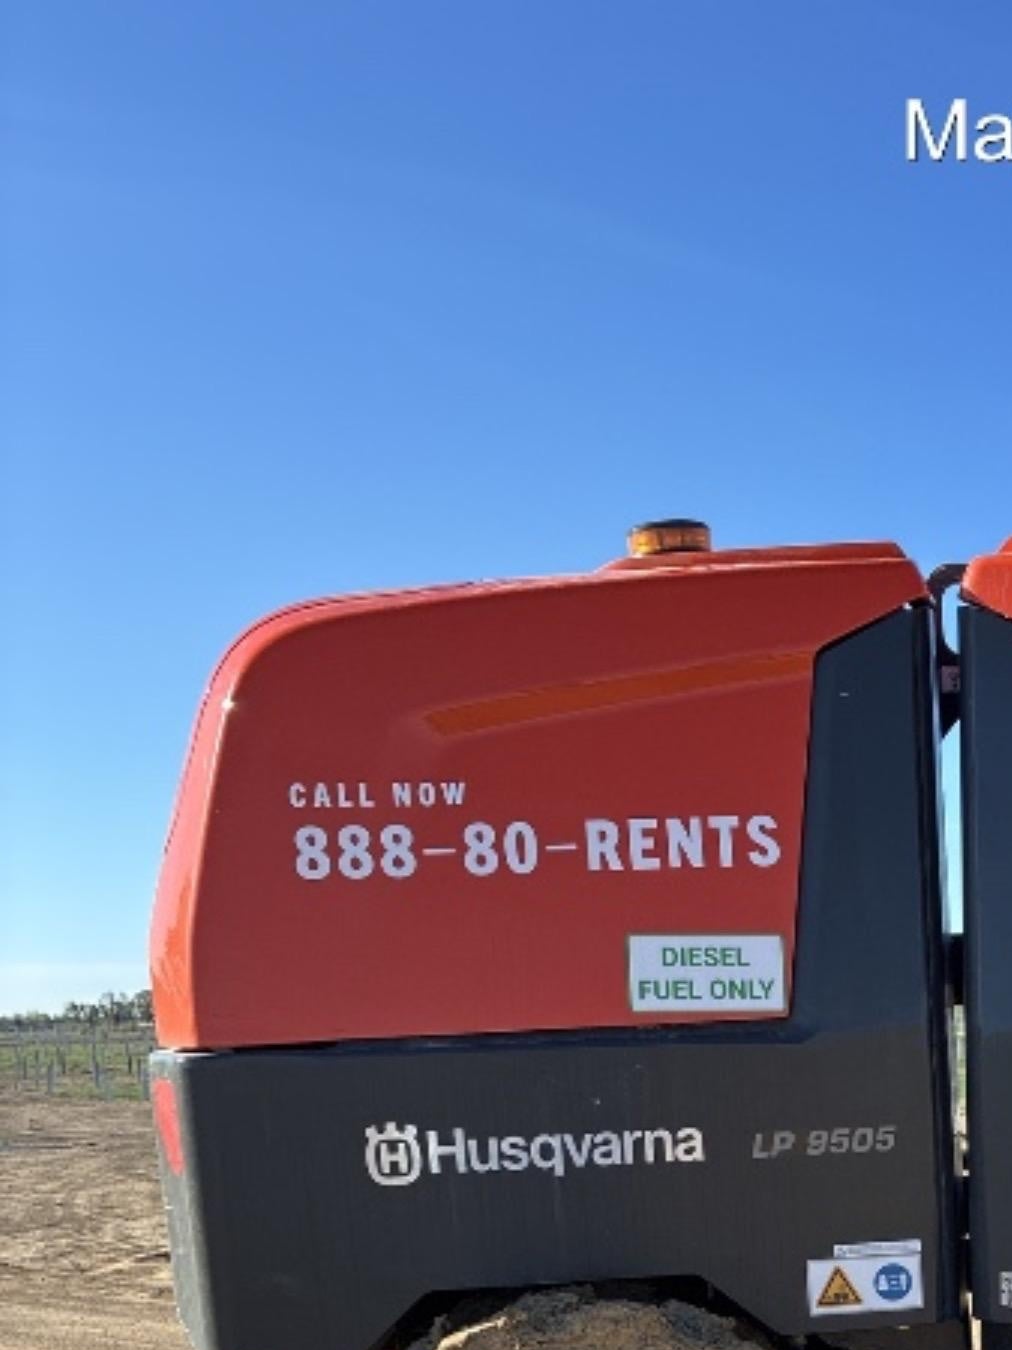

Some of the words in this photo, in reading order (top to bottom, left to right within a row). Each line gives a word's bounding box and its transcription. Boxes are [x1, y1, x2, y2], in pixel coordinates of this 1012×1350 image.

[289, 782, 375, 808] CALL
[392, 782, 467, 807] NOW
[294, 815, 782, 880] 888-80-RENTS
[660, 945, 752, 968] DIESEL
[637, 977, 704, 1001] FUEL
[709, 977, 776, 1001] ONLY
[425, 1126, 706, 1177] Husqvarna
[752, 1130, 796, 1159] LP
[806, 1124, 897, 1157] 9505
